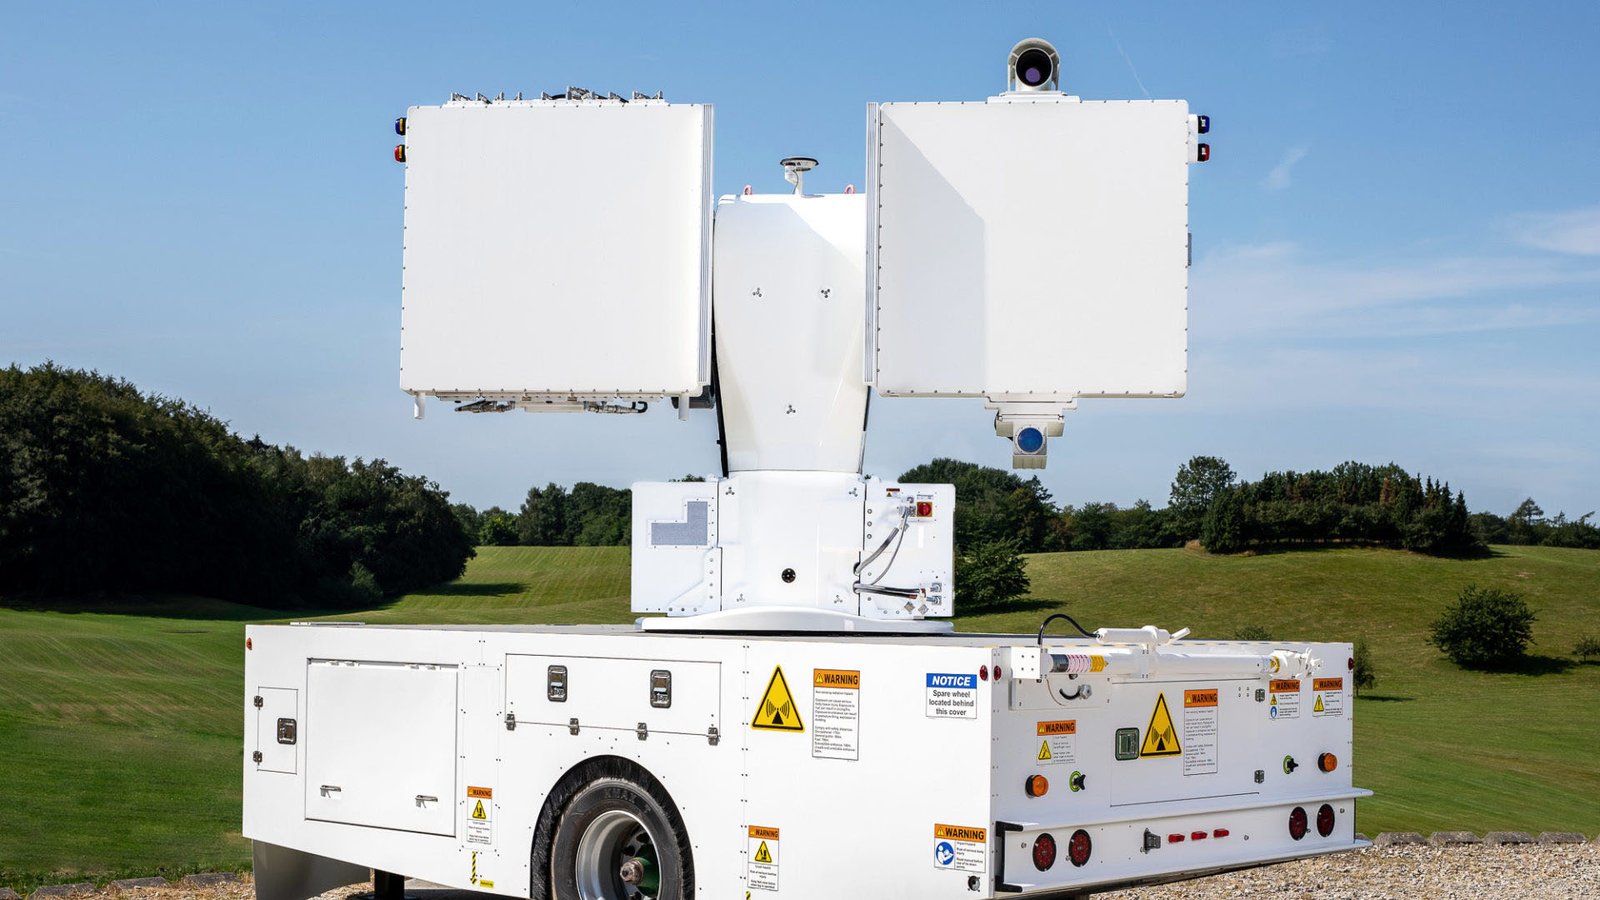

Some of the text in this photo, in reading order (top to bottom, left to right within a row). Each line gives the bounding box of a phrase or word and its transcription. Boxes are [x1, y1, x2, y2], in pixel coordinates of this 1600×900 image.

[824, 674, 858, 685] WARNING
[932, 675, 971, 686] NOTICE
[1319, 680, 1342, 688] WARNING
[1275, 681, 1299, 689] WARNING
[932, 690, 951, 698] Spare
[1191, 693, 1217, 703] WARNING
[1045, 723, 1075, 733] WARNING
[472, 789, 492, 797] WARNING
[755, 829, 778, 838] WARNING
[945, 828, 985, 840] WARNING
